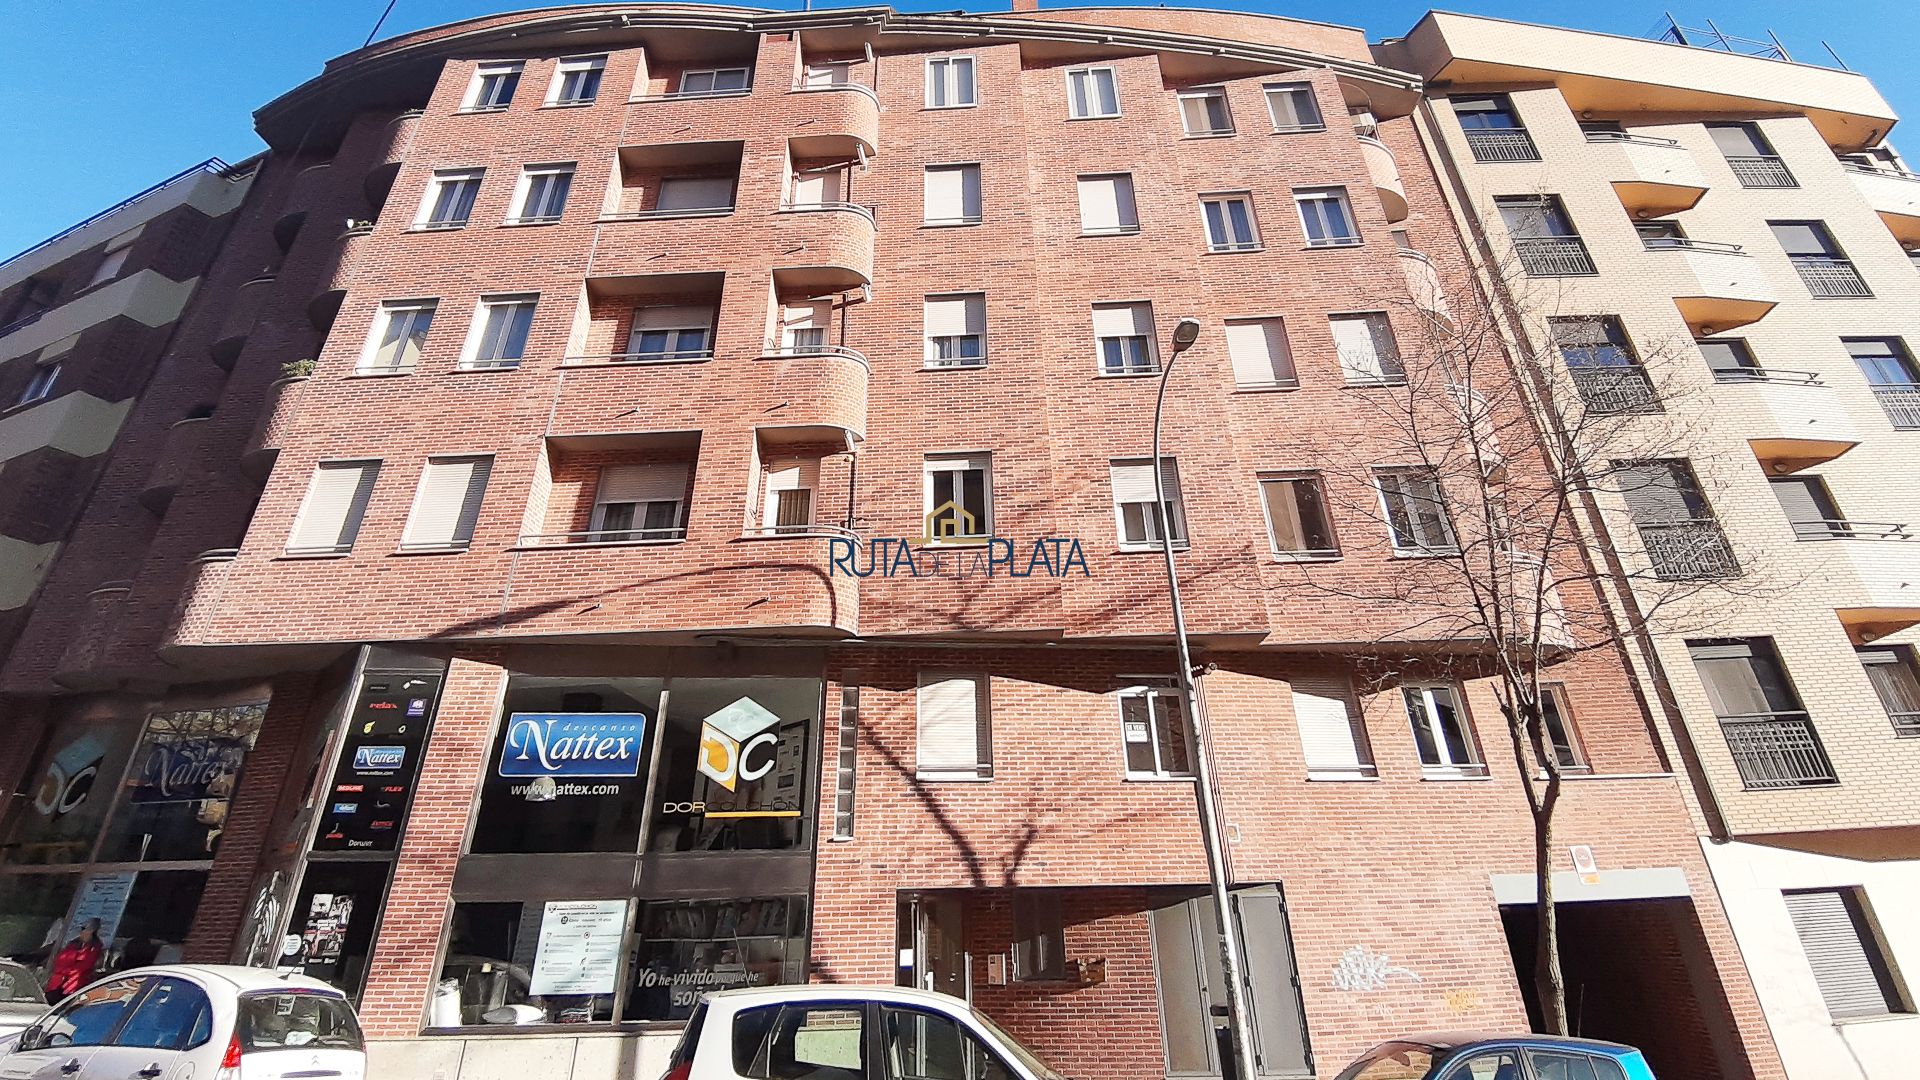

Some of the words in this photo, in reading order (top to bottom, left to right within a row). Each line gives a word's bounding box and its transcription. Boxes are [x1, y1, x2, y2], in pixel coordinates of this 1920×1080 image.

[563, 723, 637, 732] descanso
[509, 719, 634, 771] Nattex
[357, 748, 401, 767] Nattex
[511, 783, 620, 796] wwwnattex.com
[638, 968, 657, 988] Yo
[658, 974, 671, 986] he
[673, 968, 714, 985] vivido
